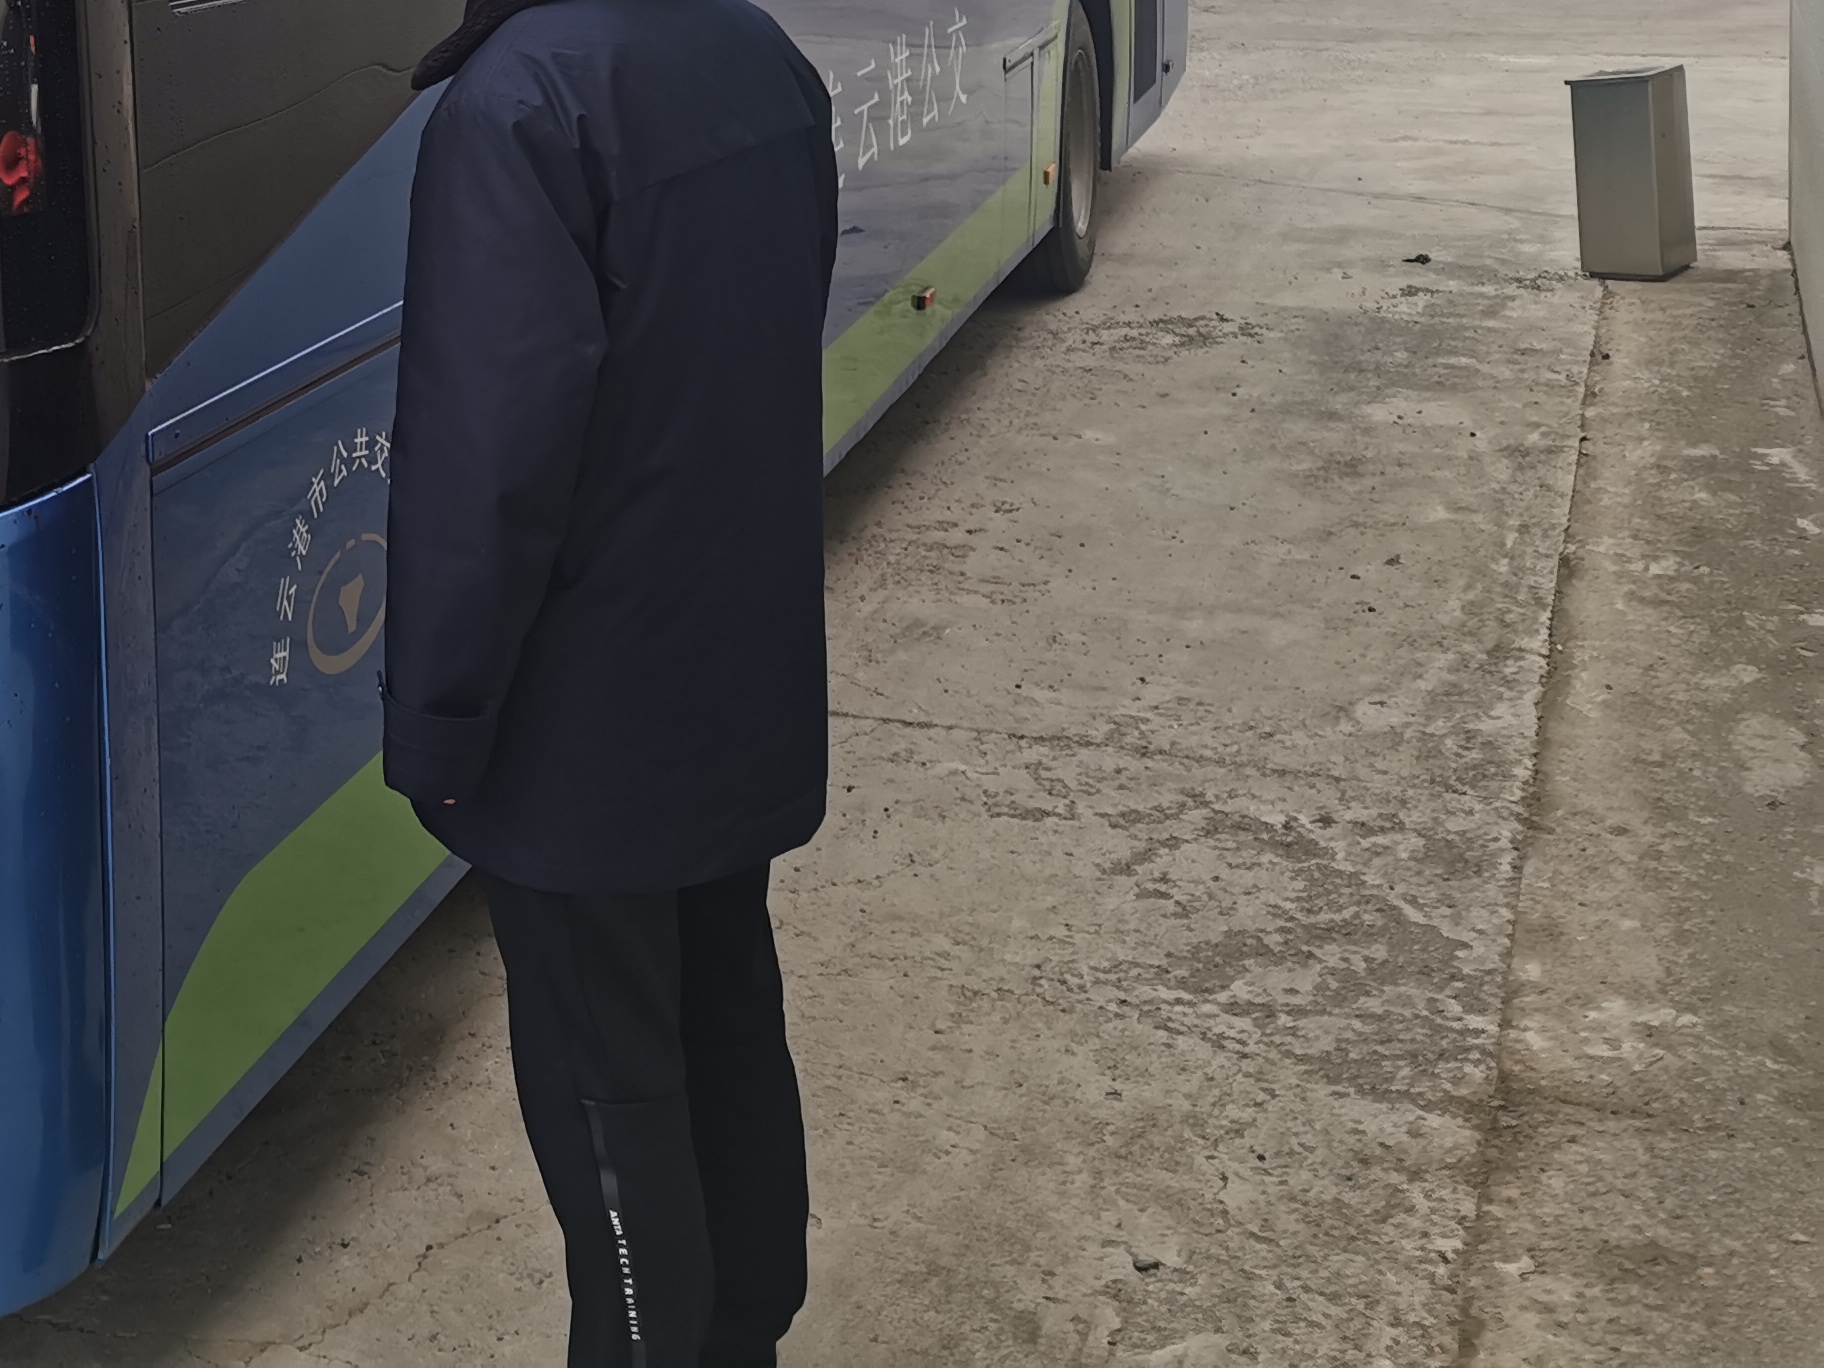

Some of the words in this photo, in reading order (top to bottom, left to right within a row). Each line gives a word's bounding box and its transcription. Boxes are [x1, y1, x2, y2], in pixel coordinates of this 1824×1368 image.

[609, 1209, 623, 1236] ANTA
[617, 1239, 631, 1275] TECH
[623, 1278, 641, 1341] TRAINING
